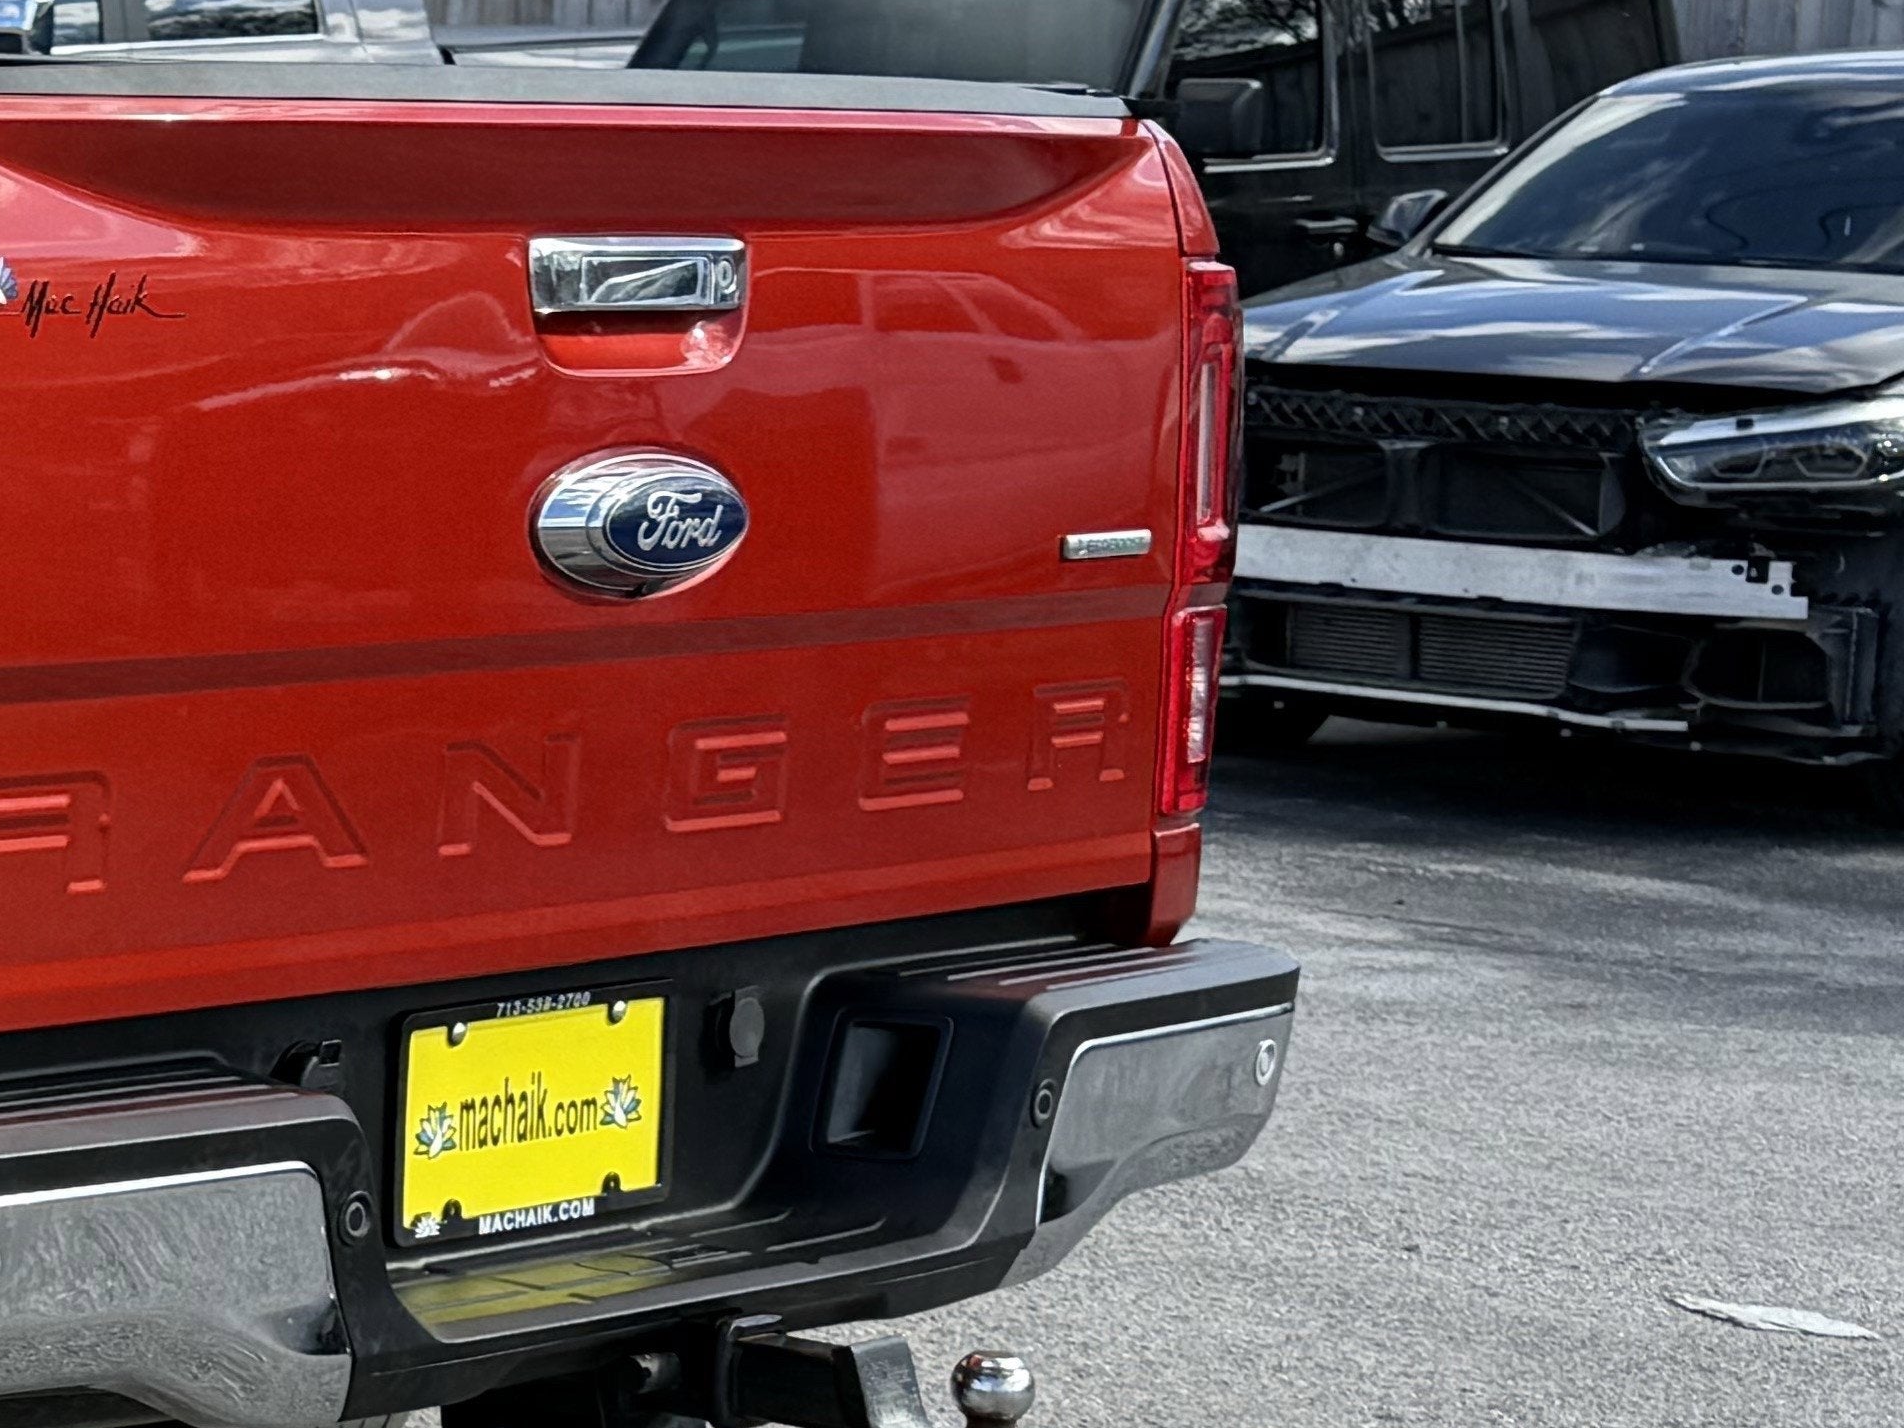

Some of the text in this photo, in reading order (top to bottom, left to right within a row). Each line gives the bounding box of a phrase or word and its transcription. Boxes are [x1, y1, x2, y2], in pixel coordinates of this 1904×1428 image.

[85, 270, 187, 339] Haik
[637, 490, 724, 551] Ford
[459, 1071, 598, 1152] machaik.com
[478, 1197, 595, 1235] MACHAIK.COM
